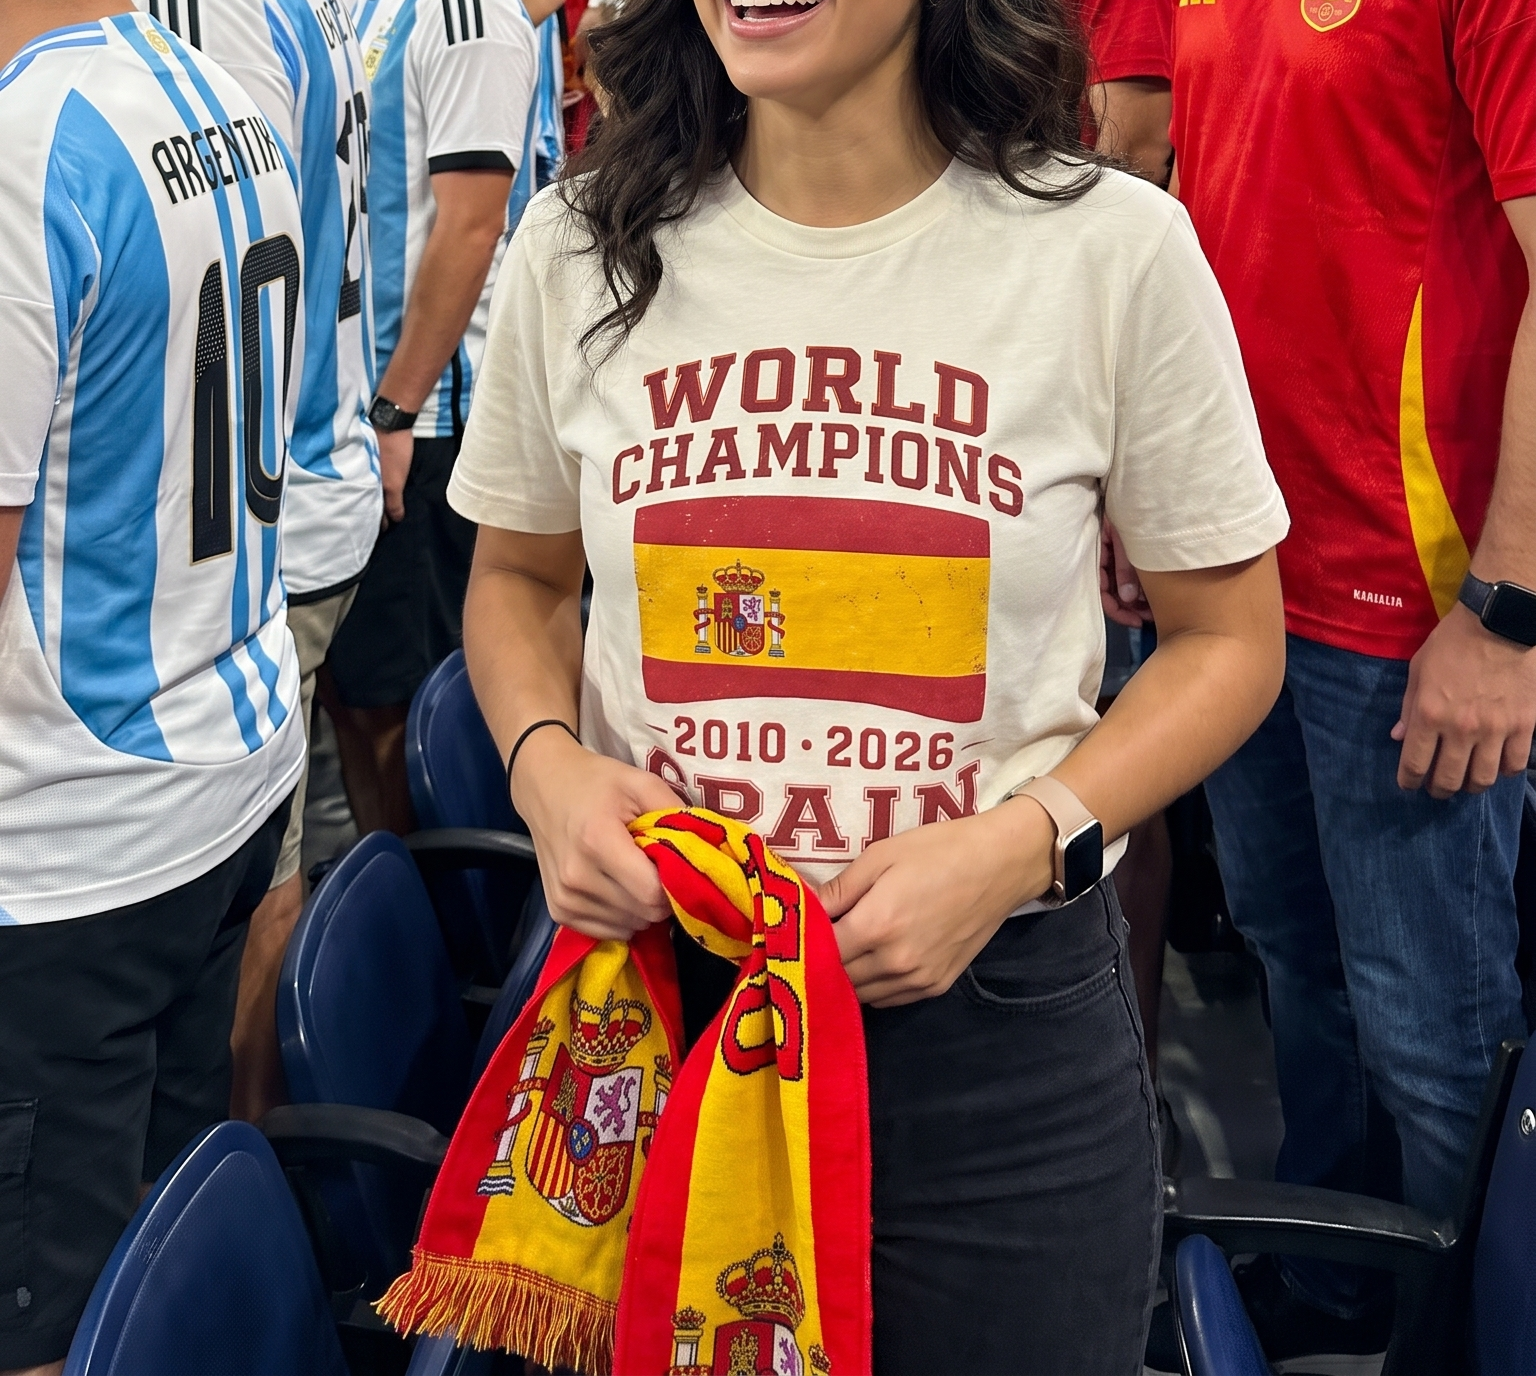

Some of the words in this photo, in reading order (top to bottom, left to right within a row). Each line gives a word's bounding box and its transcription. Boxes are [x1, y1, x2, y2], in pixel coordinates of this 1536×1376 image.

[190, 230, 300, 566] 10
[643, 345, 989, 438] WORLD
[612, 422, 1024, 518] CHAMPIONS
[674, 716, 787, 763] 2010
[826, 725, 955, 773] 2026
